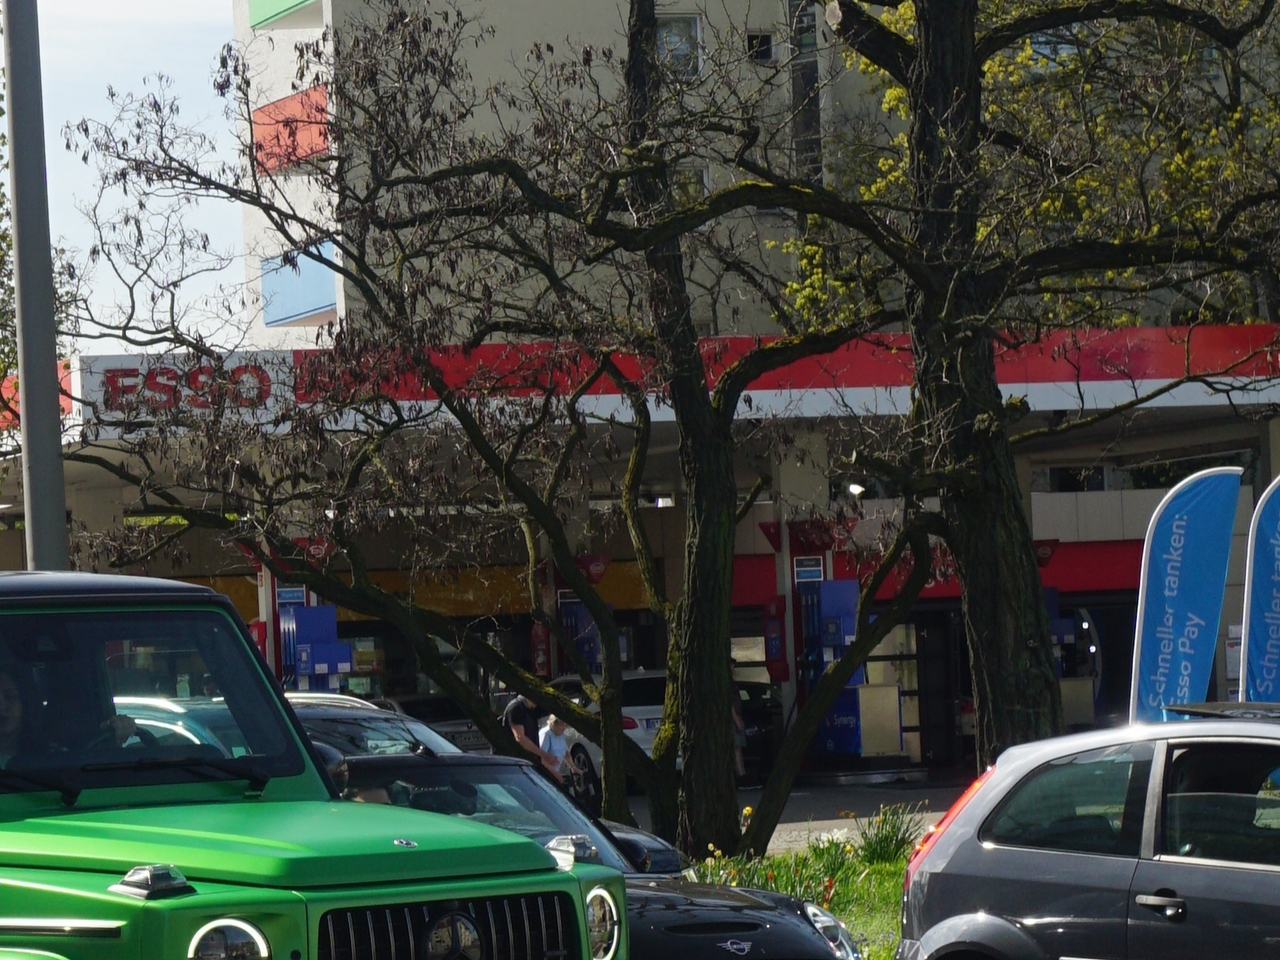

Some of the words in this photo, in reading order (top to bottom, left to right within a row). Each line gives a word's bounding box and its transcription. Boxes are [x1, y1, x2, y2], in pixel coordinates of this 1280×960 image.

[104, 365, 271, 411] ESSO
[1149, 607, 1174, 707] Schneller
[1163, 514, 1187, 597] tanken:
[1178, 611, 1206, 654] Pay
[834, 714, 856, 728] Synergy
